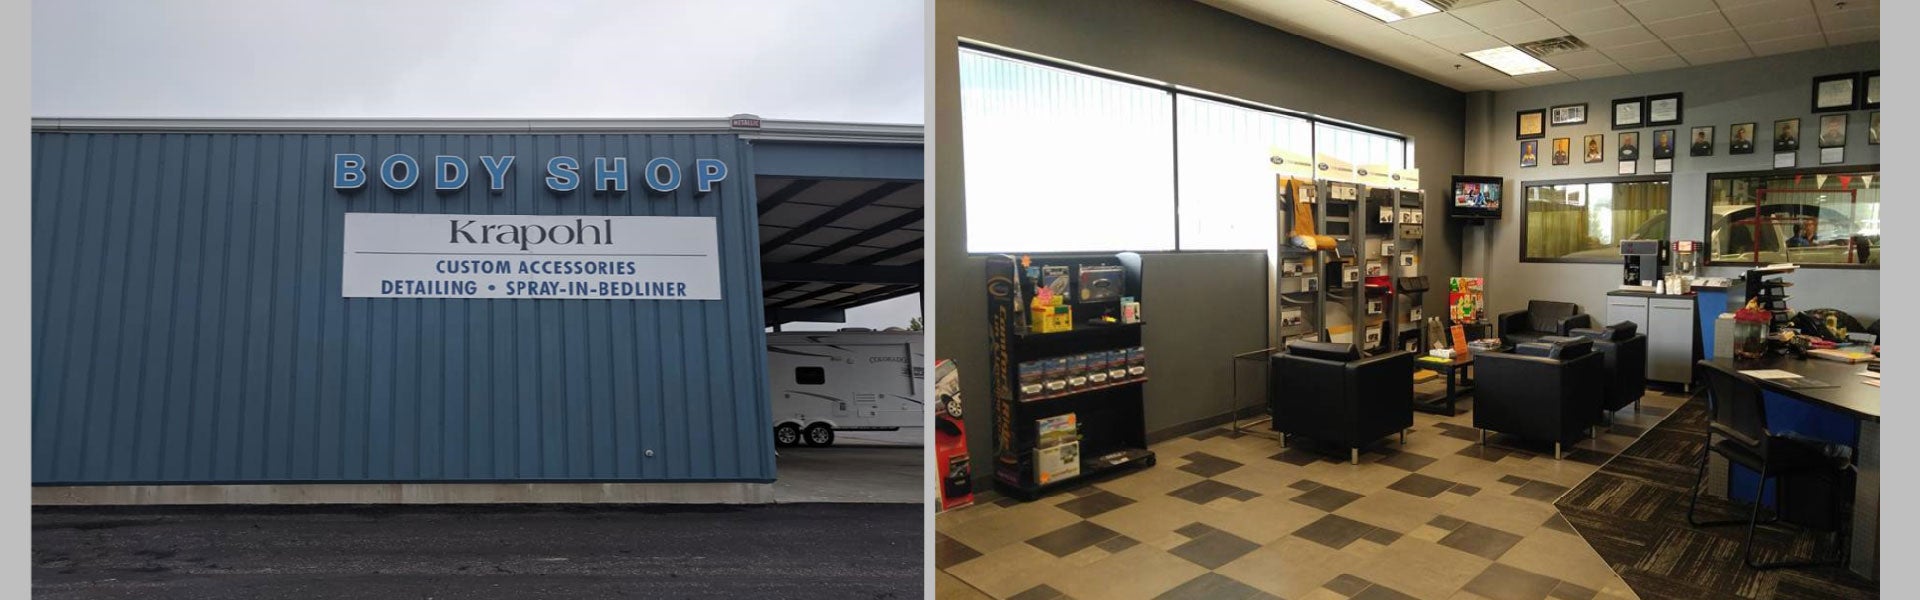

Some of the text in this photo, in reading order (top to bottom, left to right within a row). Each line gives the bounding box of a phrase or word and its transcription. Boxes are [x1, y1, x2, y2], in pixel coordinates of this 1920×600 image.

[334, 153, 728, 192] BODY SHOP
[449, 218, 614, 251] Krapohl
[436, 260, 636, 275] CUSTOM ACCESSORIES
[381, 280, 687, 297] DETAILING SPRAY-IN-BEDLINER
